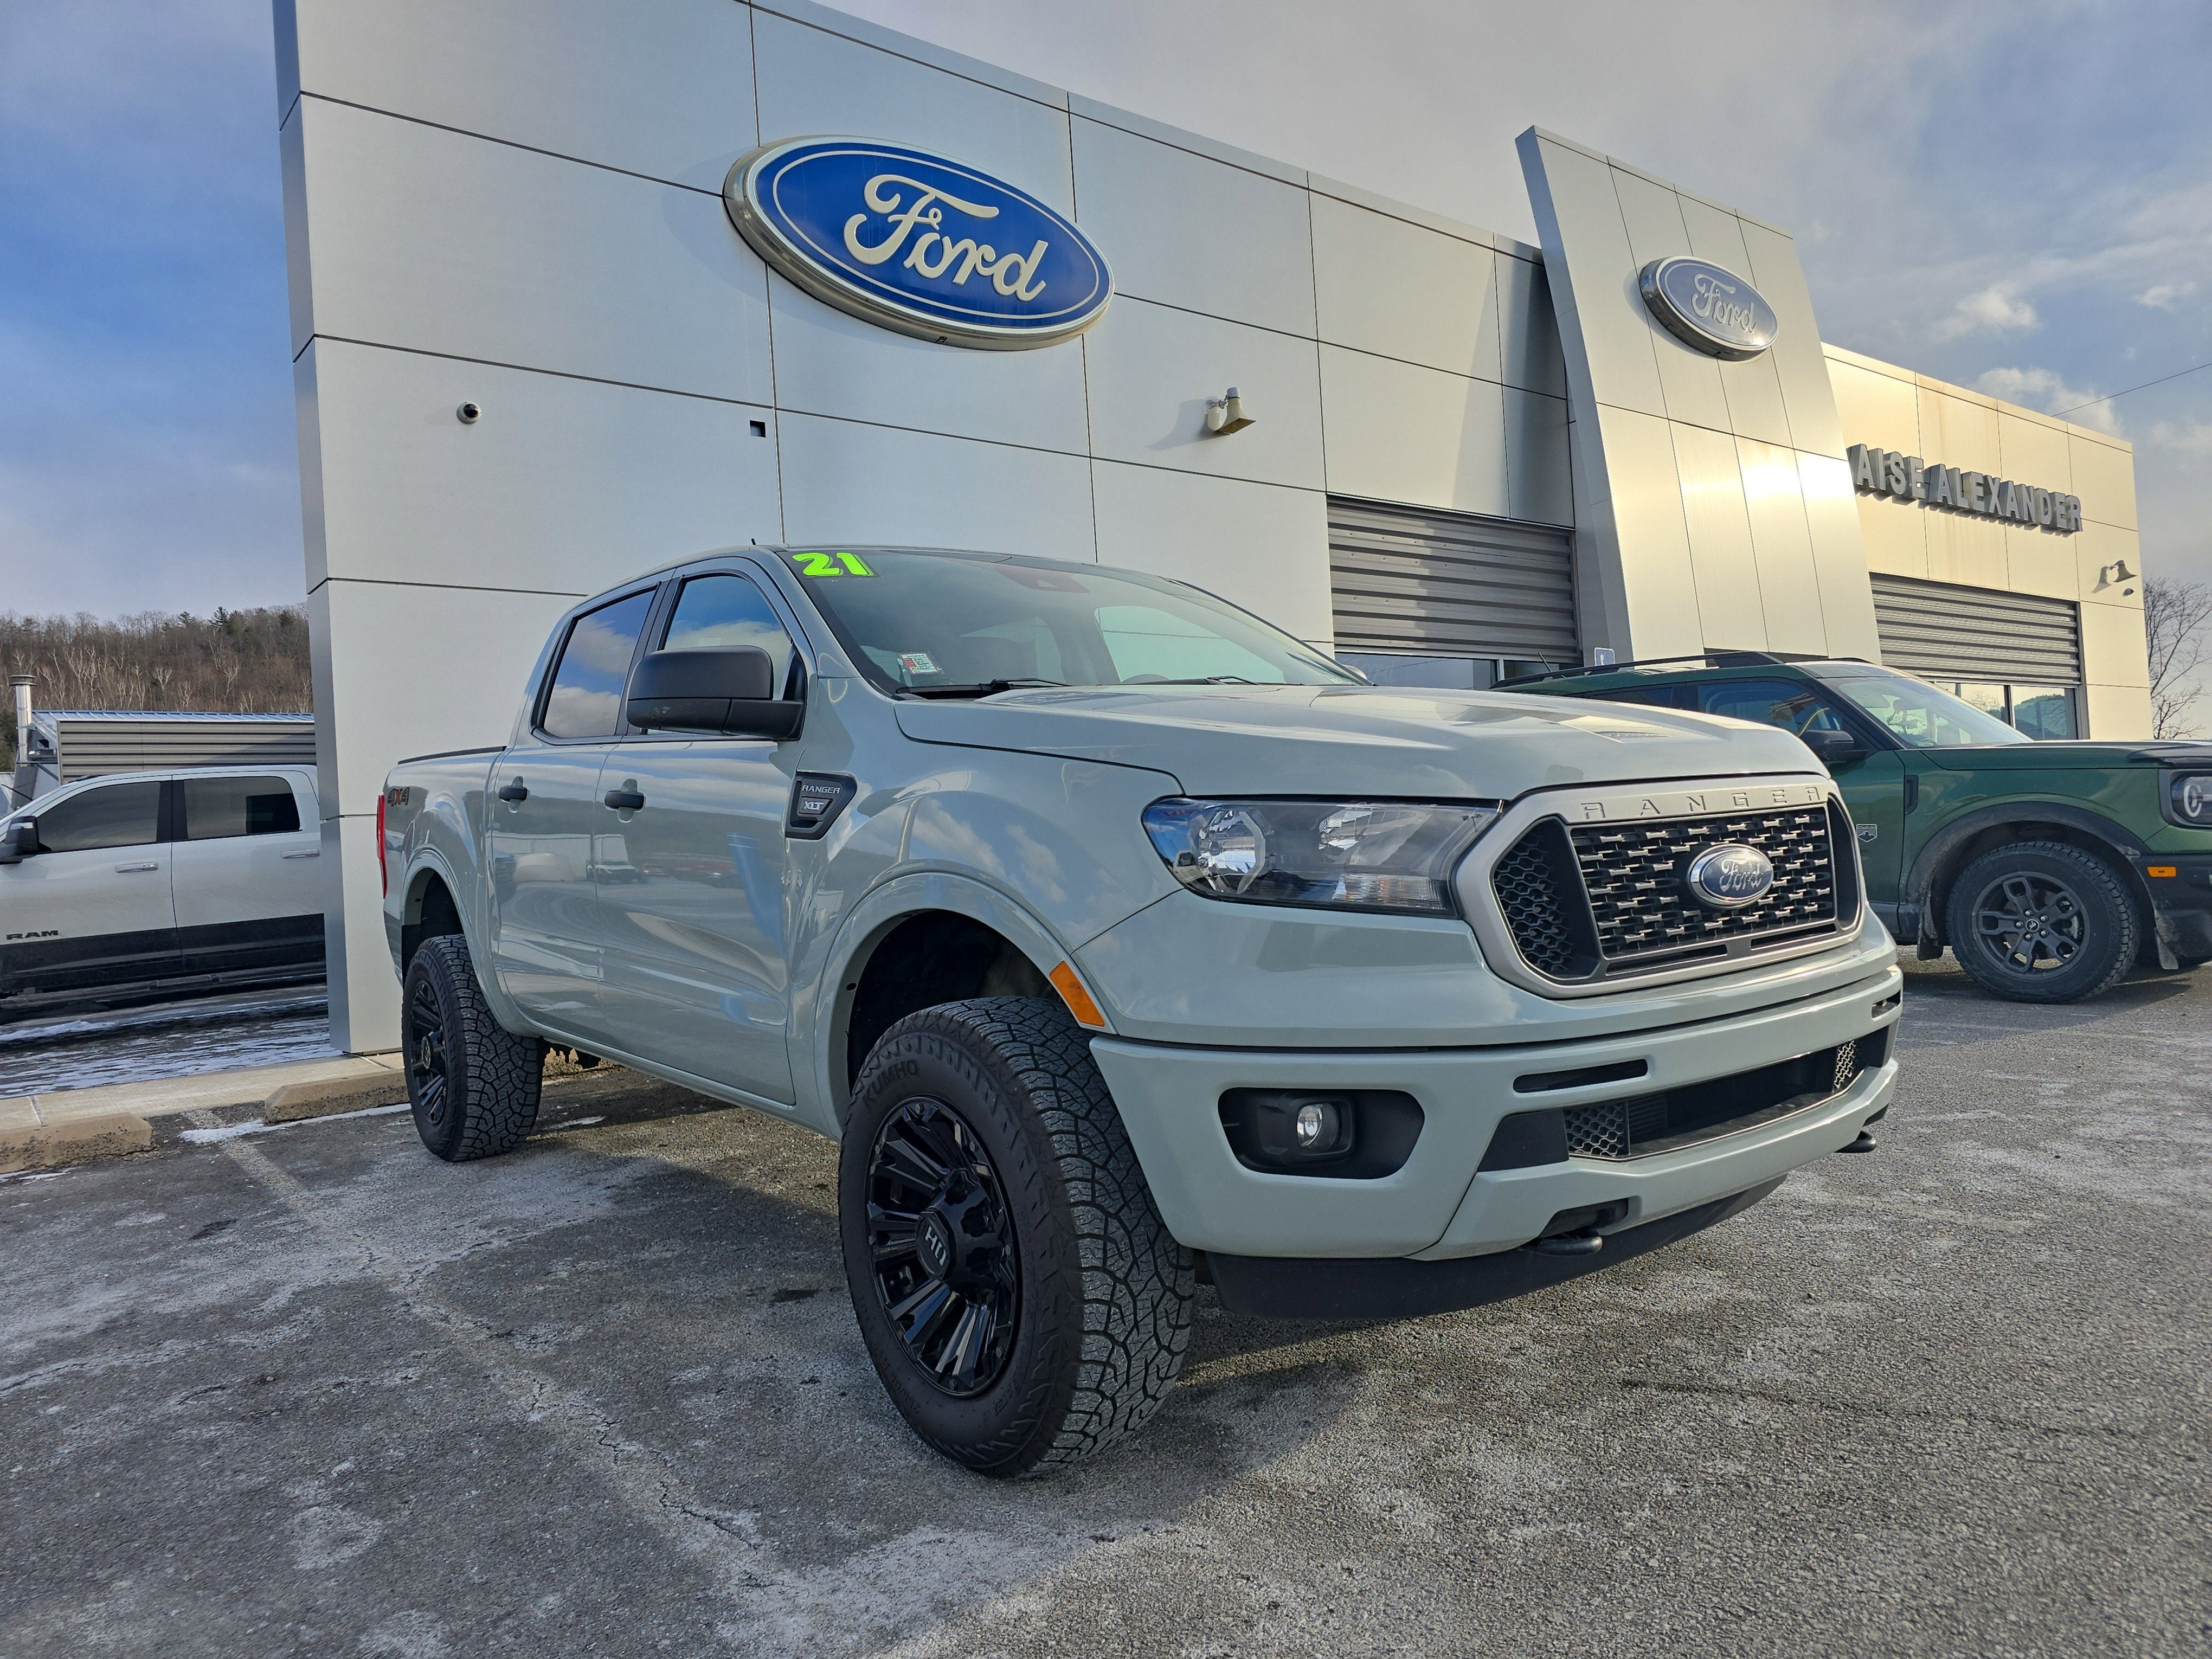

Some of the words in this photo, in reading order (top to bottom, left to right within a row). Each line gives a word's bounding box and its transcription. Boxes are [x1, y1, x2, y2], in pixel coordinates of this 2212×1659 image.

[844, 173, 1046, 302] Ford
[1691, 273, 1757, 334] Ford
[1928, 464, 2083, 532] ALEXANDER
[792, 552, 874, 577] 21
[801, 785, 841, 794] RANGER
[802, 801, 824, 811] XLT
[1580, 786, 1829, 820] RANGER
[1719, 857, 1765, 892] Ford
[6, 930, 59, 940] RAM
[863, 1059, 920, 1111] KUMHO
